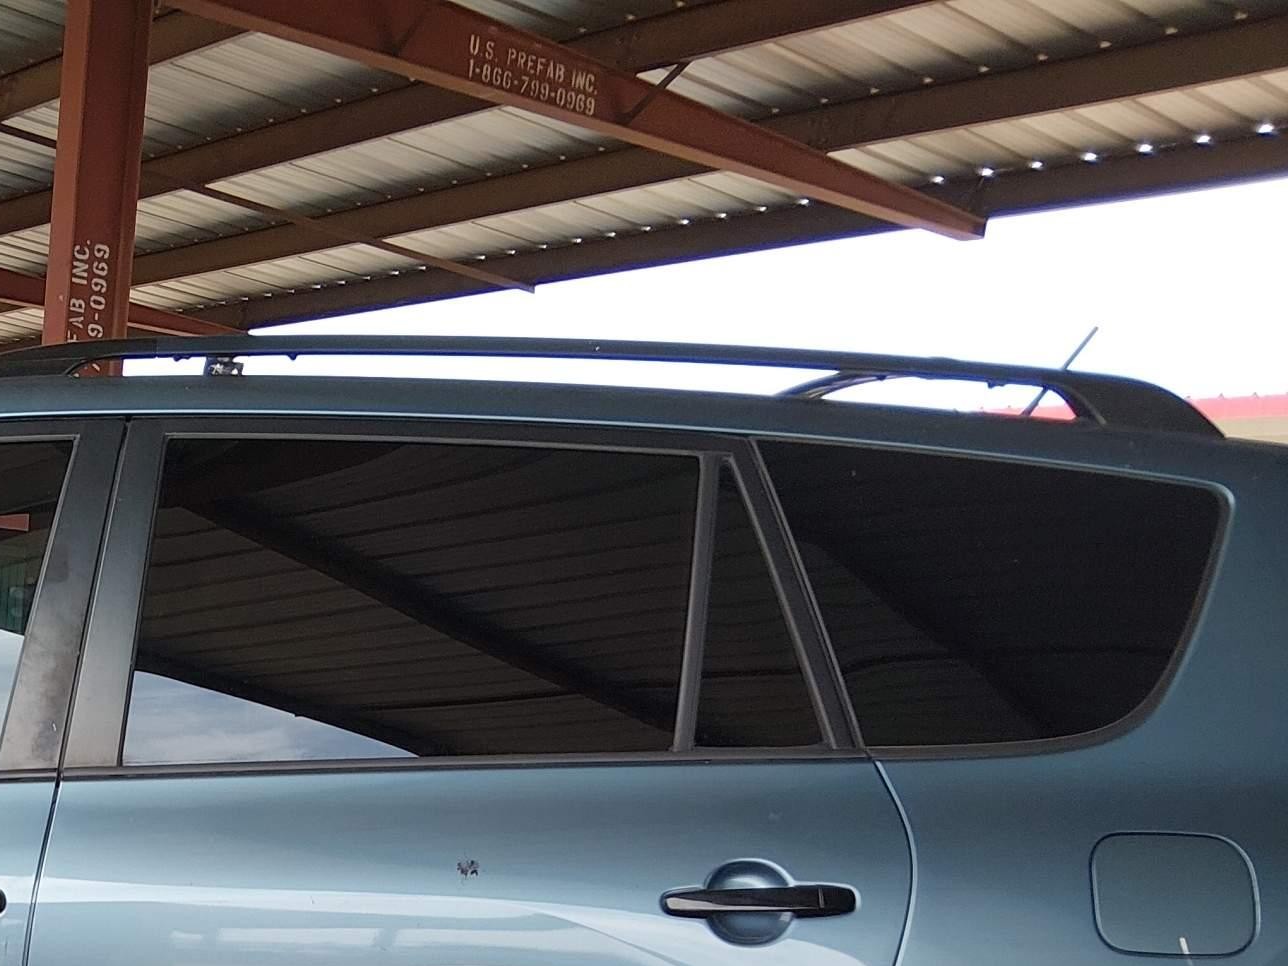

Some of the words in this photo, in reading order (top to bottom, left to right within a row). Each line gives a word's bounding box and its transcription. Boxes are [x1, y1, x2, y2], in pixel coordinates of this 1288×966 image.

[468, 59, 595, 116] 1-866-799-0969
[469, 34, 498, 62] U.S.
[507, 48, 565, 83] PREFAB
[571, 69, 598, 95] INC.
[71, 239, 90, 285] INC.
[66, 298, 85, 343] FAB
